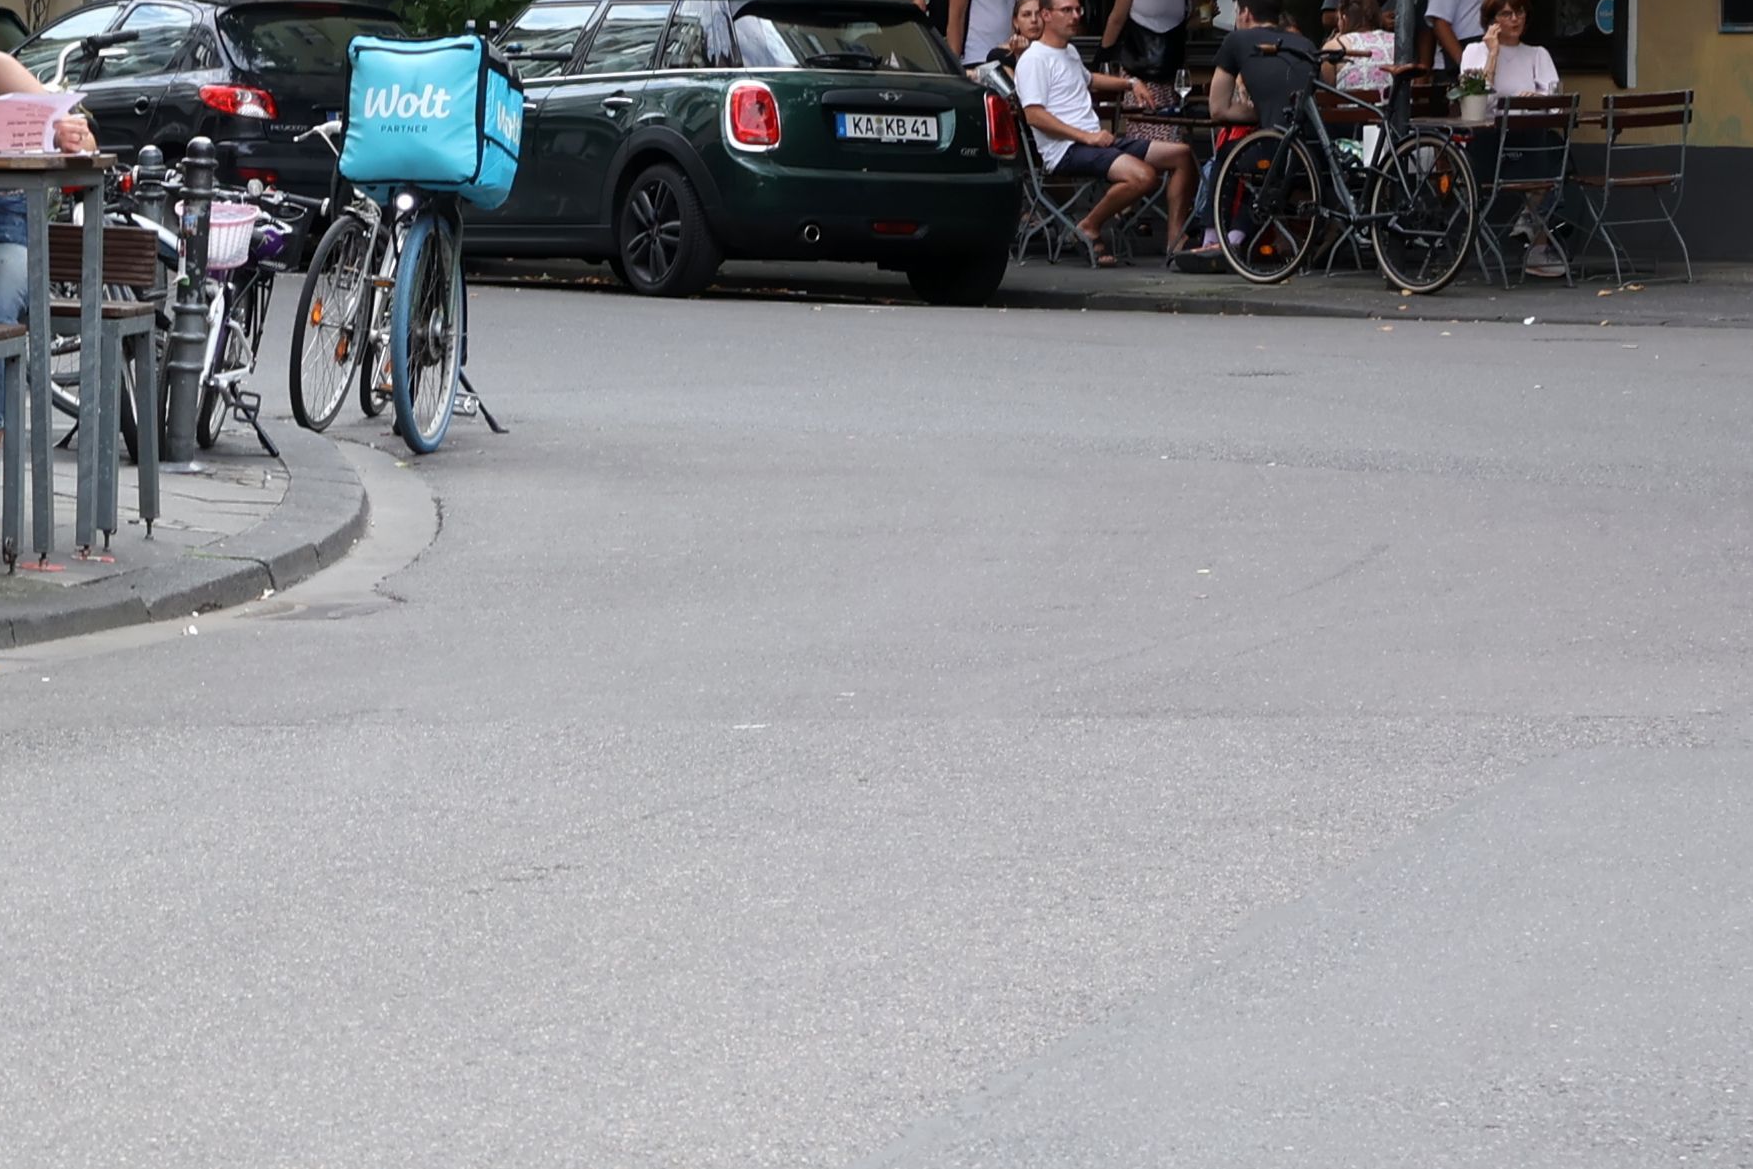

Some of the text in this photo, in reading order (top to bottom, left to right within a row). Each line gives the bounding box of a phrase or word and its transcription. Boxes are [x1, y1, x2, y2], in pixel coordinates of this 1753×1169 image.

[364, 83, 452, 120] Wolt
[380, 124, 429, 134] PARTNER
[852, 116, 931, 137] KA KB 41
